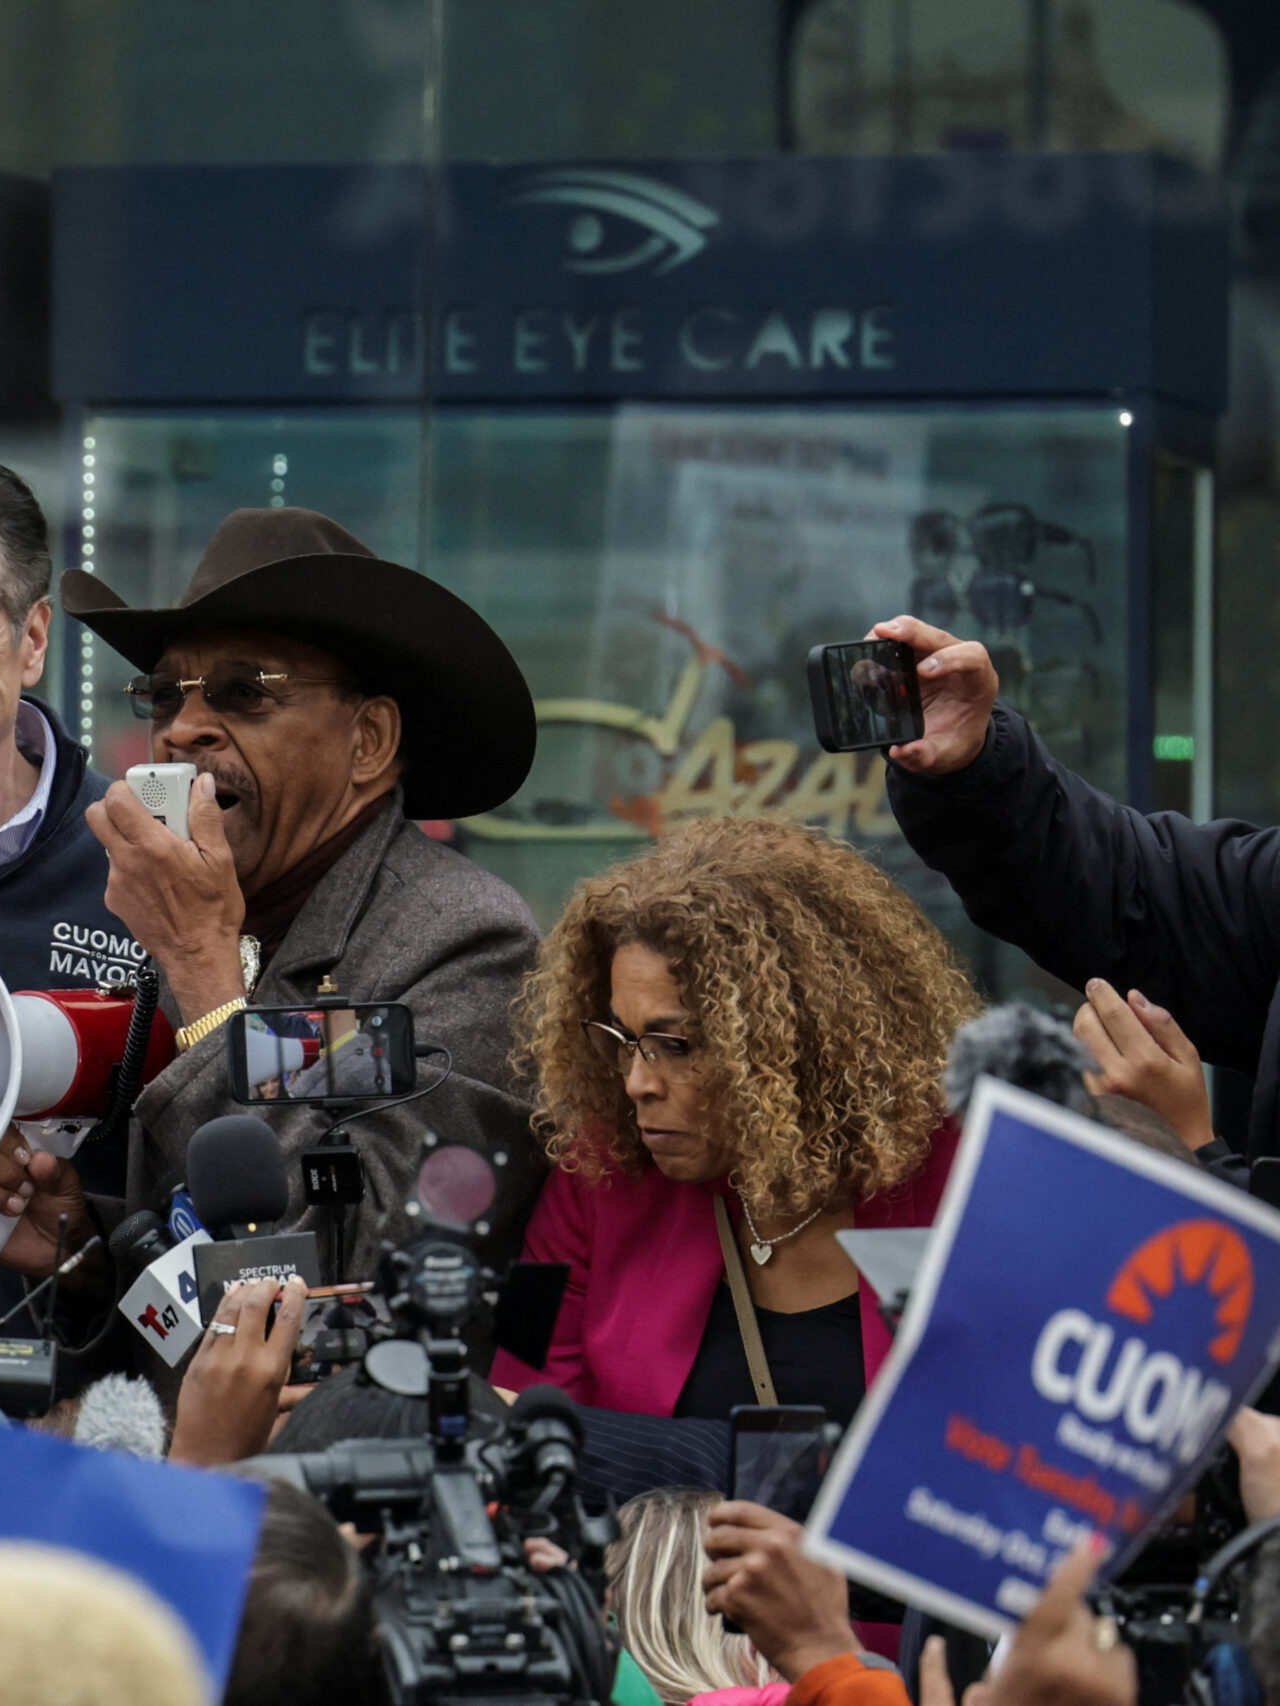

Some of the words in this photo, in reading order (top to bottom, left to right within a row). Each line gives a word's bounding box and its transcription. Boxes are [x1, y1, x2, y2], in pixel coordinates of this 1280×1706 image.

[514, 308, 647, 373] EYE
[678, 306, 896, 372] CARE
[53, 922, 147, 960] CUOMO
[239, 1263, 297, 1280] SPECTRUM
[161, 1303, 180, 1331] 47
